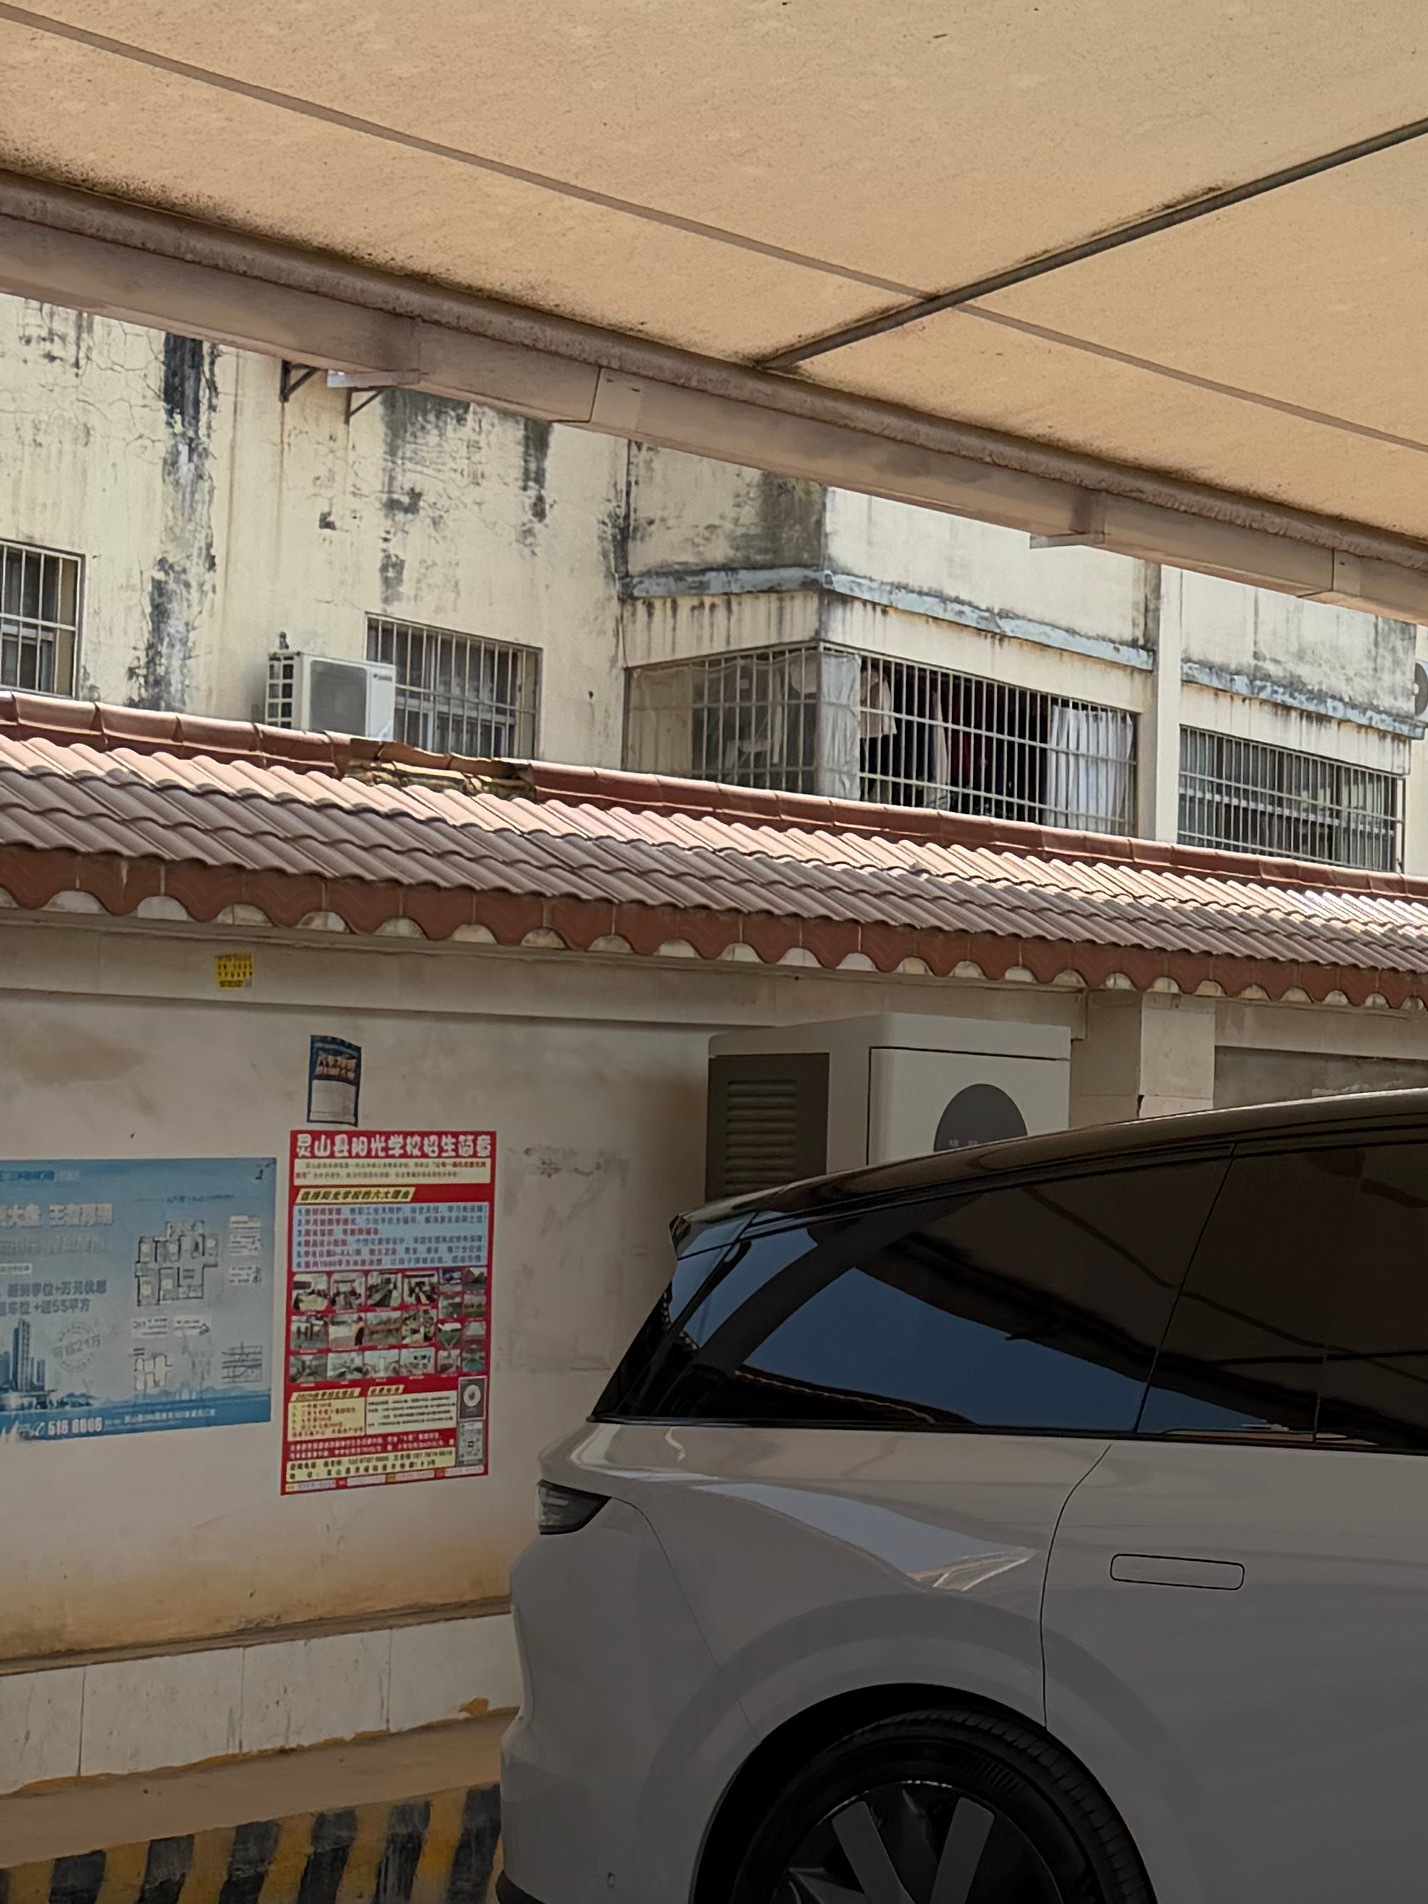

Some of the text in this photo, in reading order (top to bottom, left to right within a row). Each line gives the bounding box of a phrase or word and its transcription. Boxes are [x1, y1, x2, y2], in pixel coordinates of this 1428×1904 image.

[296, 1133, 491, 1157] 灵山县阳光学校招生简章
